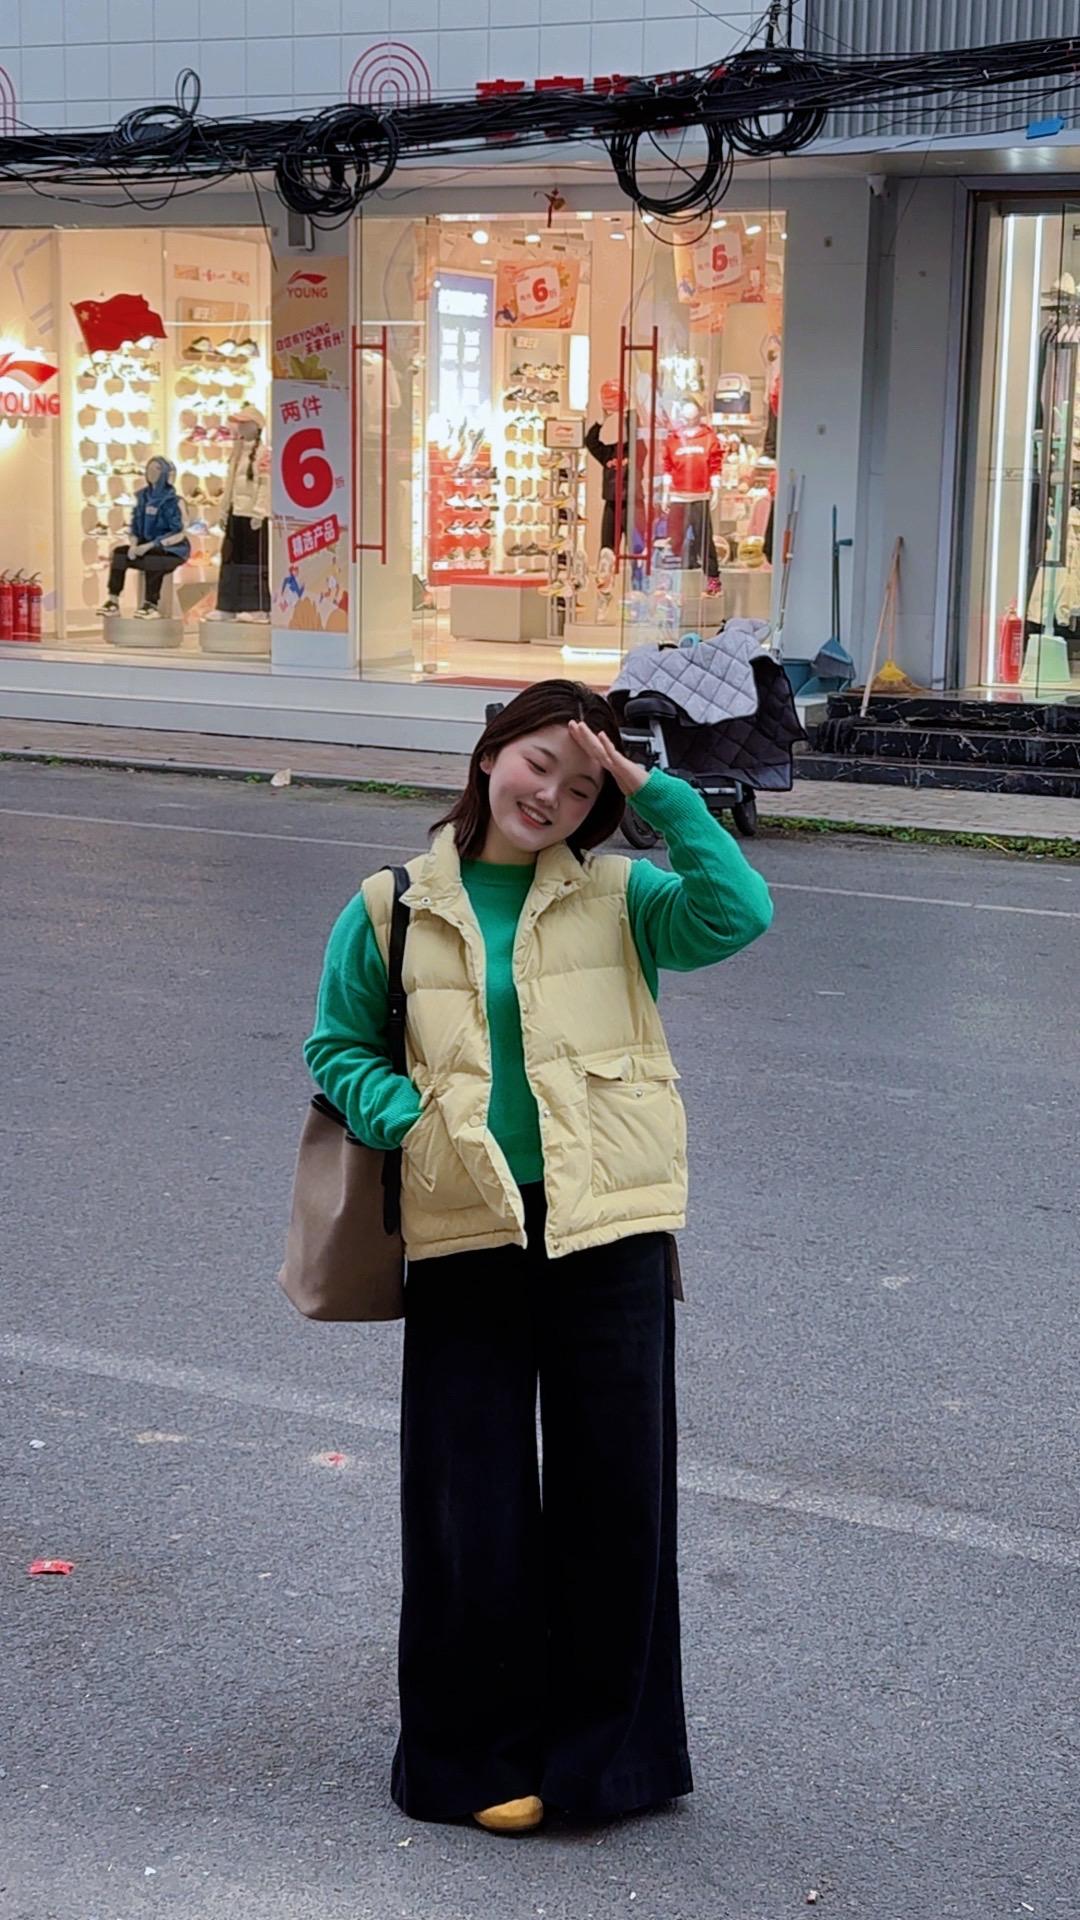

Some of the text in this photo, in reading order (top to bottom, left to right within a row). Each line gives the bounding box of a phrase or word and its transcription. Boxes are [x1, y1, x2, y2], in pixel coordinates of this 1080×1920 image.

[712, 244, 728, 272] 6
[286, 287, 328, 298] YOUNG
[532, 278, 548, 302] 6
[0, 391, 60, 415] OUNG
[279, 395, 323, 425] 两件
